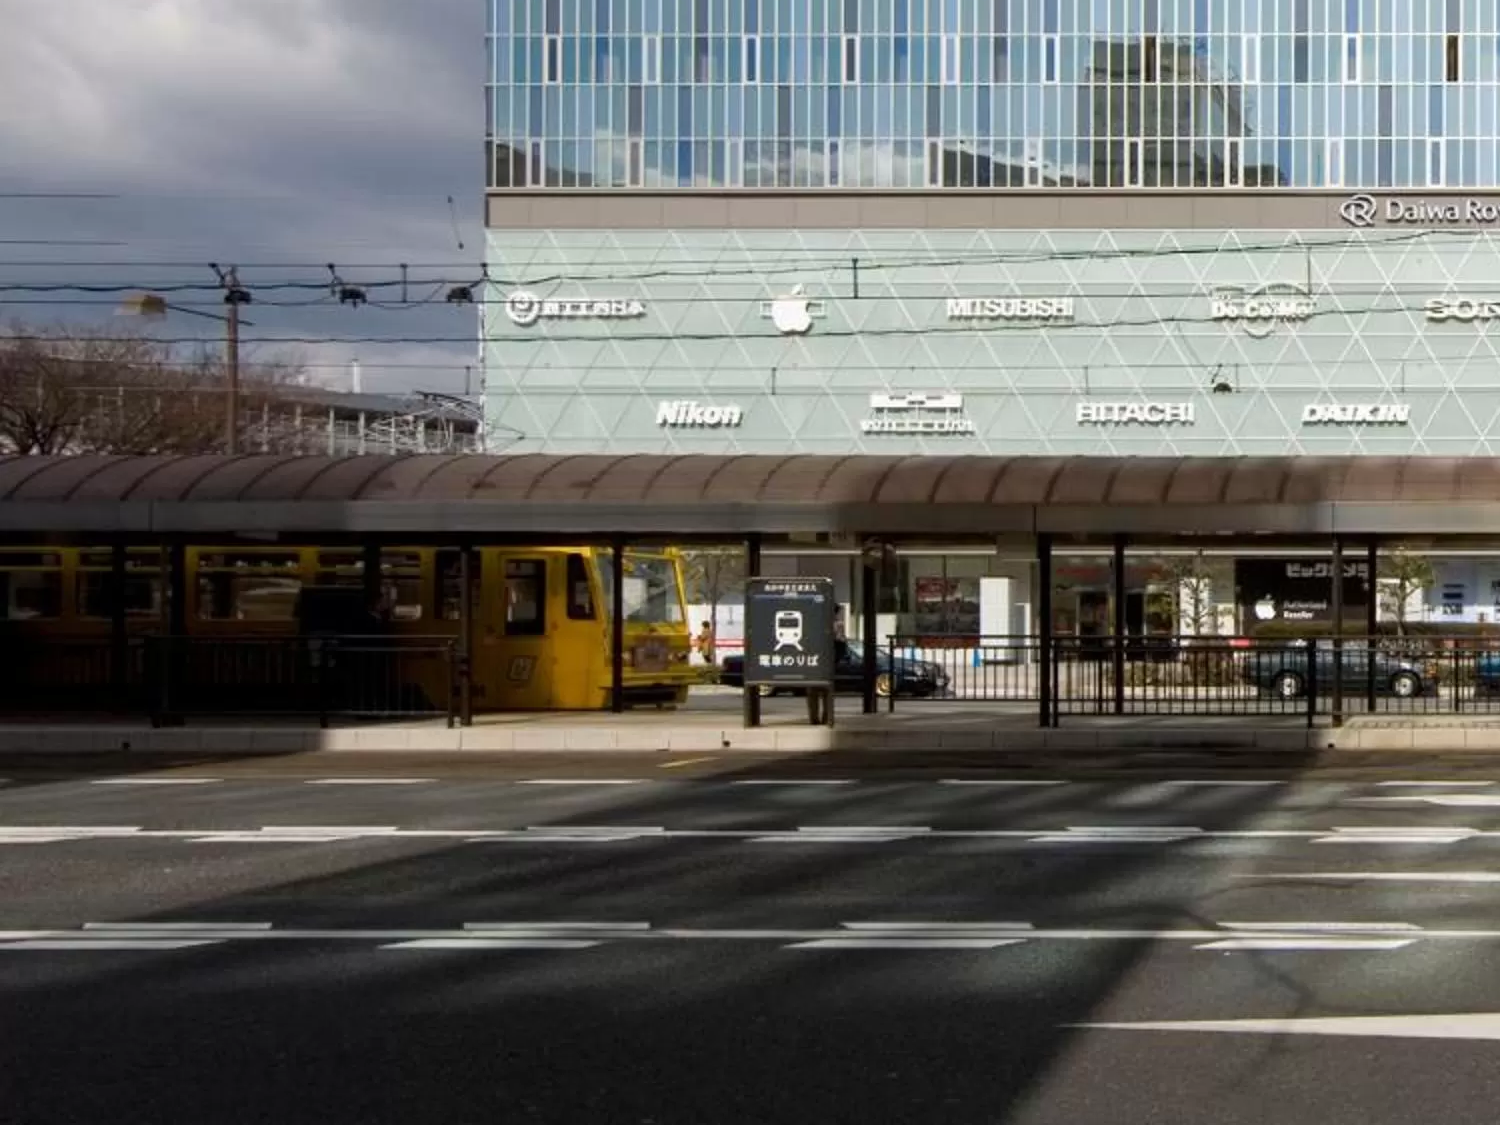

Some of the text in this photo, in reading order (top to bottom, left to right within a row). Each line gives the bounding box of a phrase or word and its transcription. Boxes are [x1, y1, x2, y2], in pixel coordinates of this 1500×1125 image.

[1385, 199, 1460, 223] Daiwa
[947, 297, 1074, 321] MITSUBISHI
[656, 400, 743, 429] Nikon
[1076, 402, 1194, 425] HITACHI
[1301, 403, 1409, 426] DAIKIN
